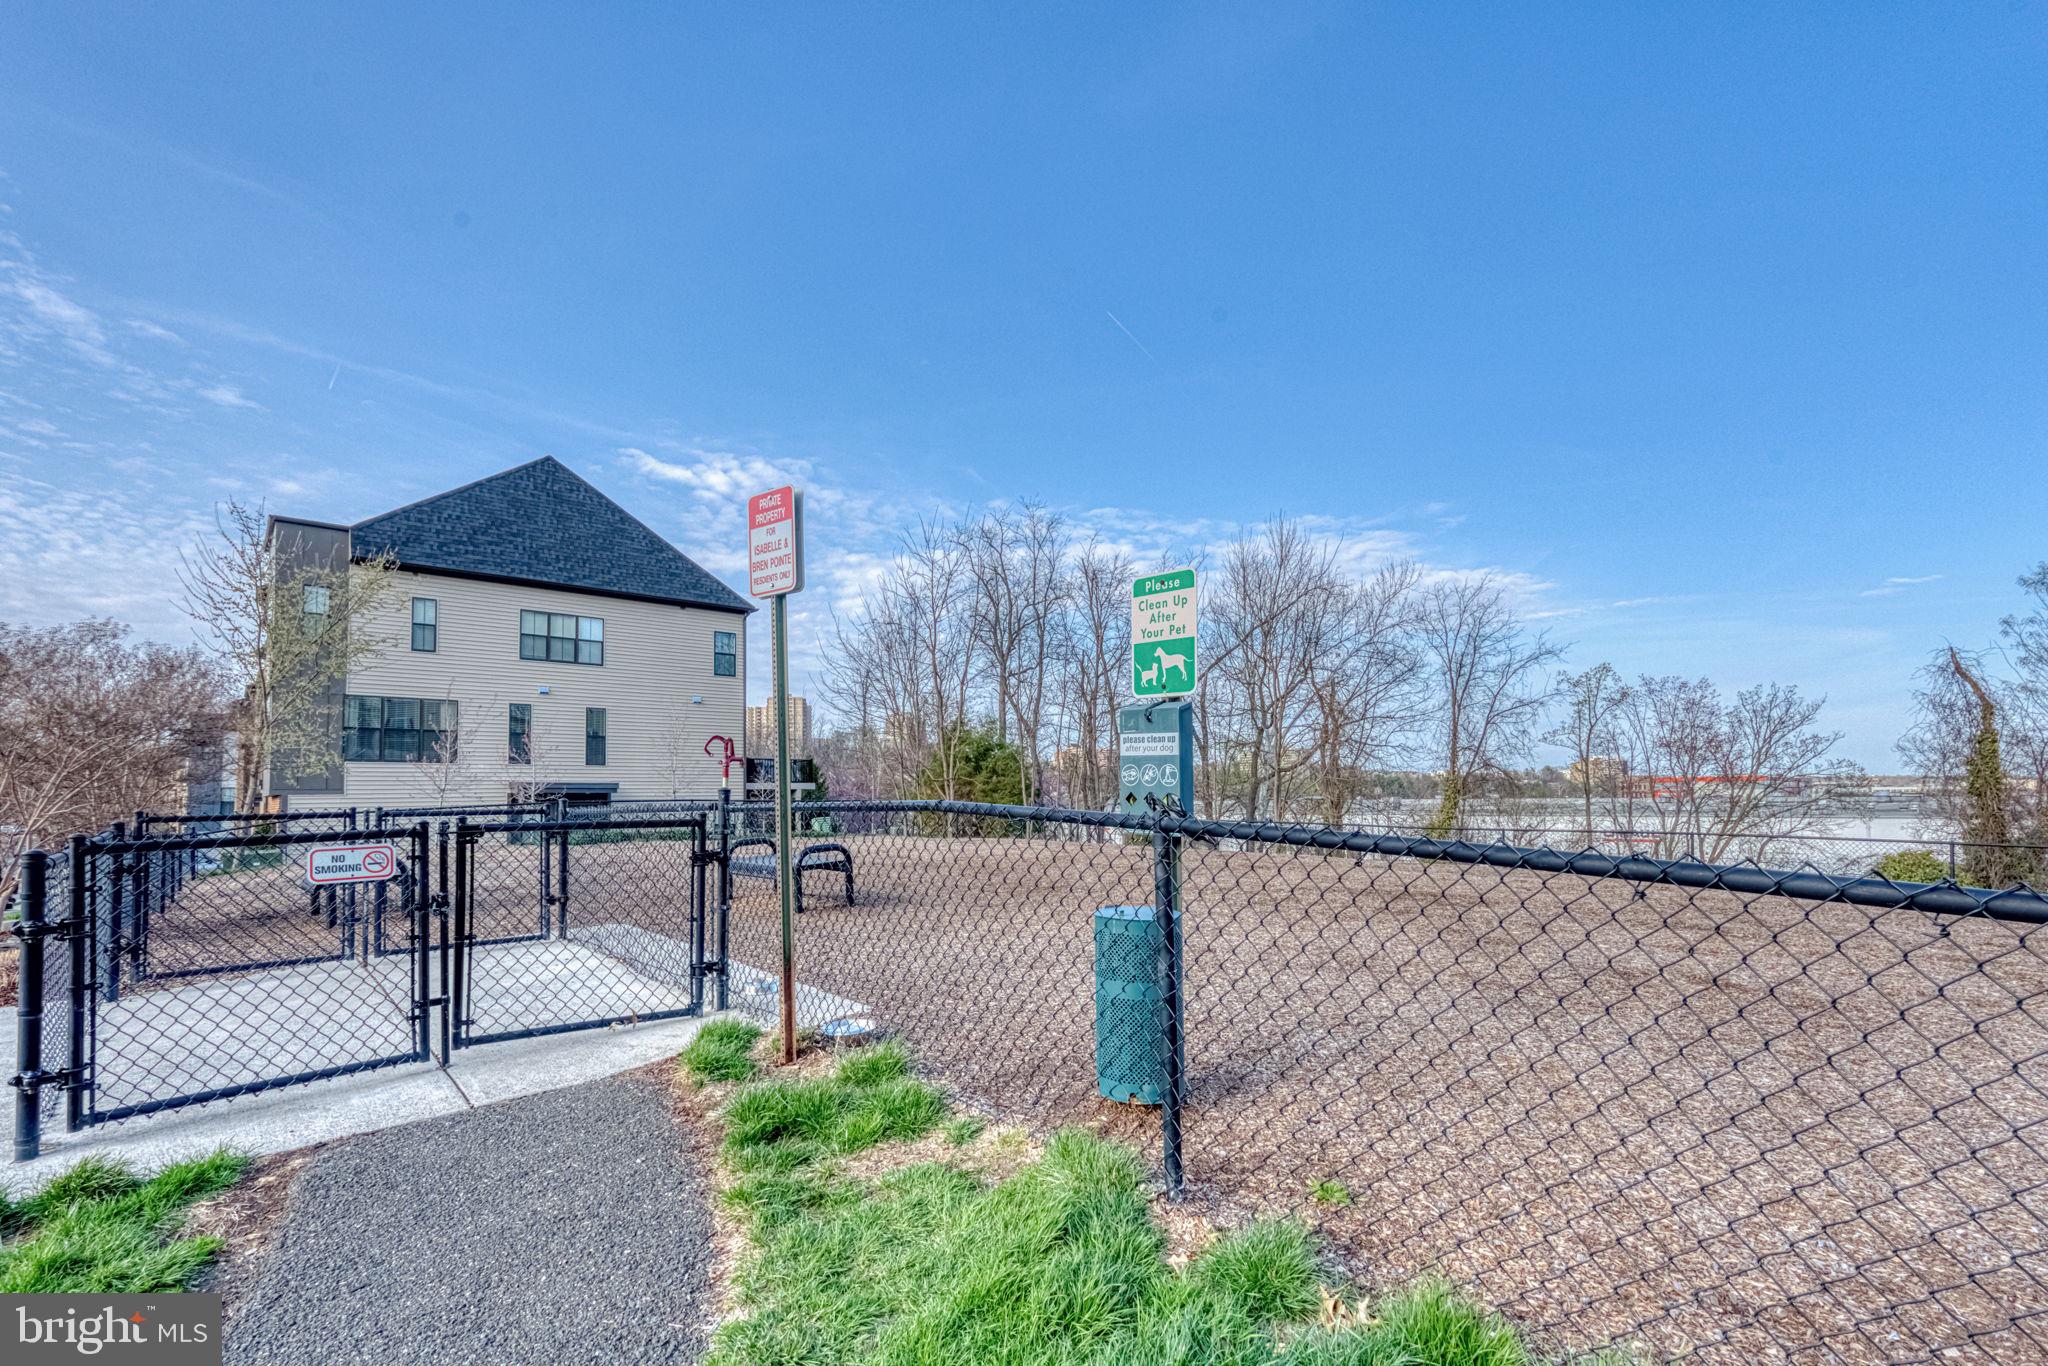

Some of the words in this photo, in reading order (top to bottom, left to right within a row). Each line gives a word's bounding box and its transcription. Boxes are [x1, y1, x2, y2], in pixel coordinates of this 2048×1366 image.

[759, 494, 781, 510] PRIVATE
[755, 507, 785, 525] PROPERTY
[766, 526, 776, 536] FOR
[754, 539, 781, 555] ISABELLE
[784, 537, 789, 549] &
[752, 560, 768, 572] BREN
[770, 553, 791, 568] POINTE
[753, 573, 778, 585] RESIDENTS
[779, 570, 791, 580] ONLY
[1145, 579, 1181, 593] Please
[1138, 598, 1168, 612] Clean
[1173, 594, 1188, 609] Up
[1149, 610, 1177, 625] After
[1140, 628, 1164, 639] Your
[1169, 624, 1186, 636] Pet
[1122, 735, 1146, 745] please
[1146, 735, 1166, 744] clean
[1167, 735, 1176, 744] up
[1125, 744, 1141, 753] after
[1142, 745, 1158, 753] your
[1160, 744, 1174, 753] dog
[331, 854, 346, 863] NO
[314, 863, 362, 875] SMOKING
